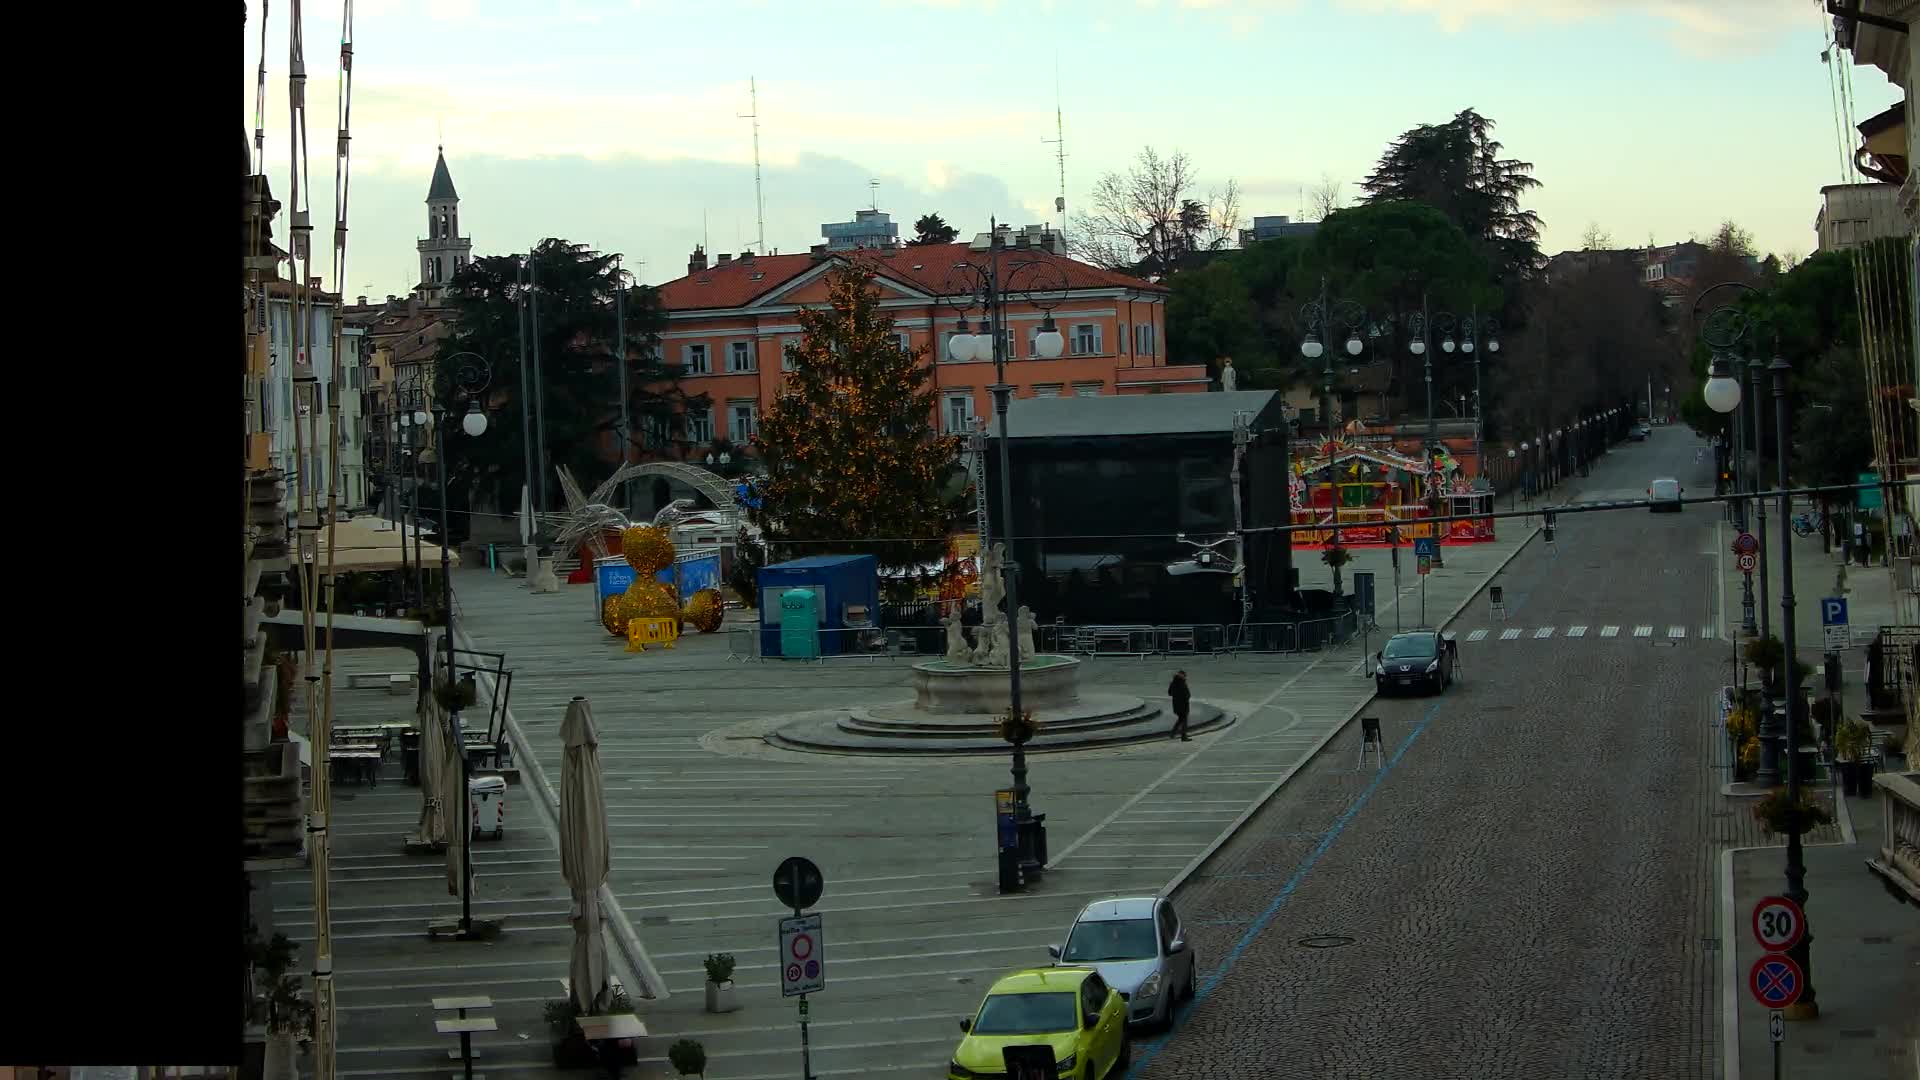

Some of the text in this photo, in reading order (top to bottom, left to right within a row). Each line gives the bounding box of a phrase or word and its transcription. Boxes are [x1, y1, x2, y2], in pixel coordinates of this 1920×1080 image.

[1742, 557, 1753, 566] 20
[1827, 602, 1842, 621] P
[1762, 911, 1791, 937] 30
